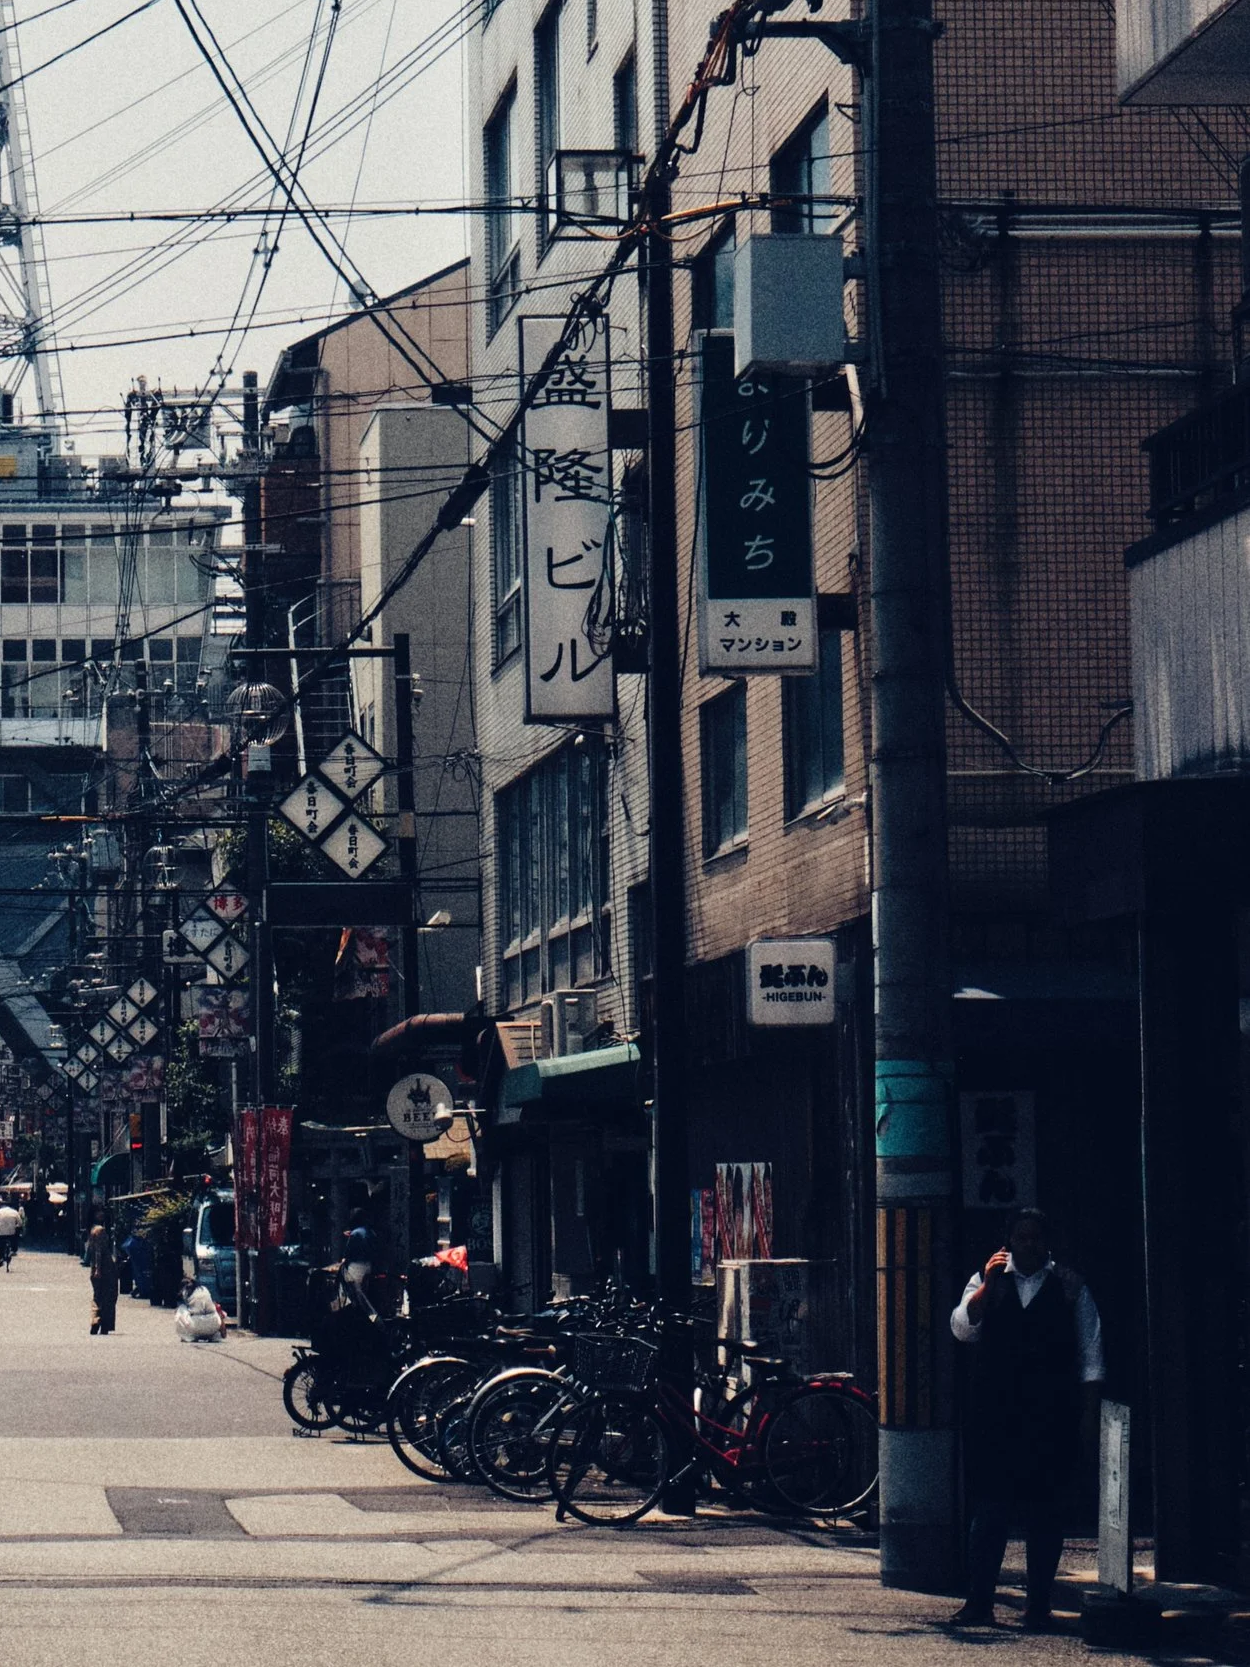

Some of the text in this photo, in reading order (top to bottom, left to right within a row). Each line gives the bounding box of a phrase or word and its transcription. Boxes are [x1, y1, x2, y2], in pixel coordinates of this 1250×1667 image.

[530, 354, 603, 681] 盛隆ビル
[720, 637, 801, 652] マンション
[403, 1112, 438, 1123] BEE
